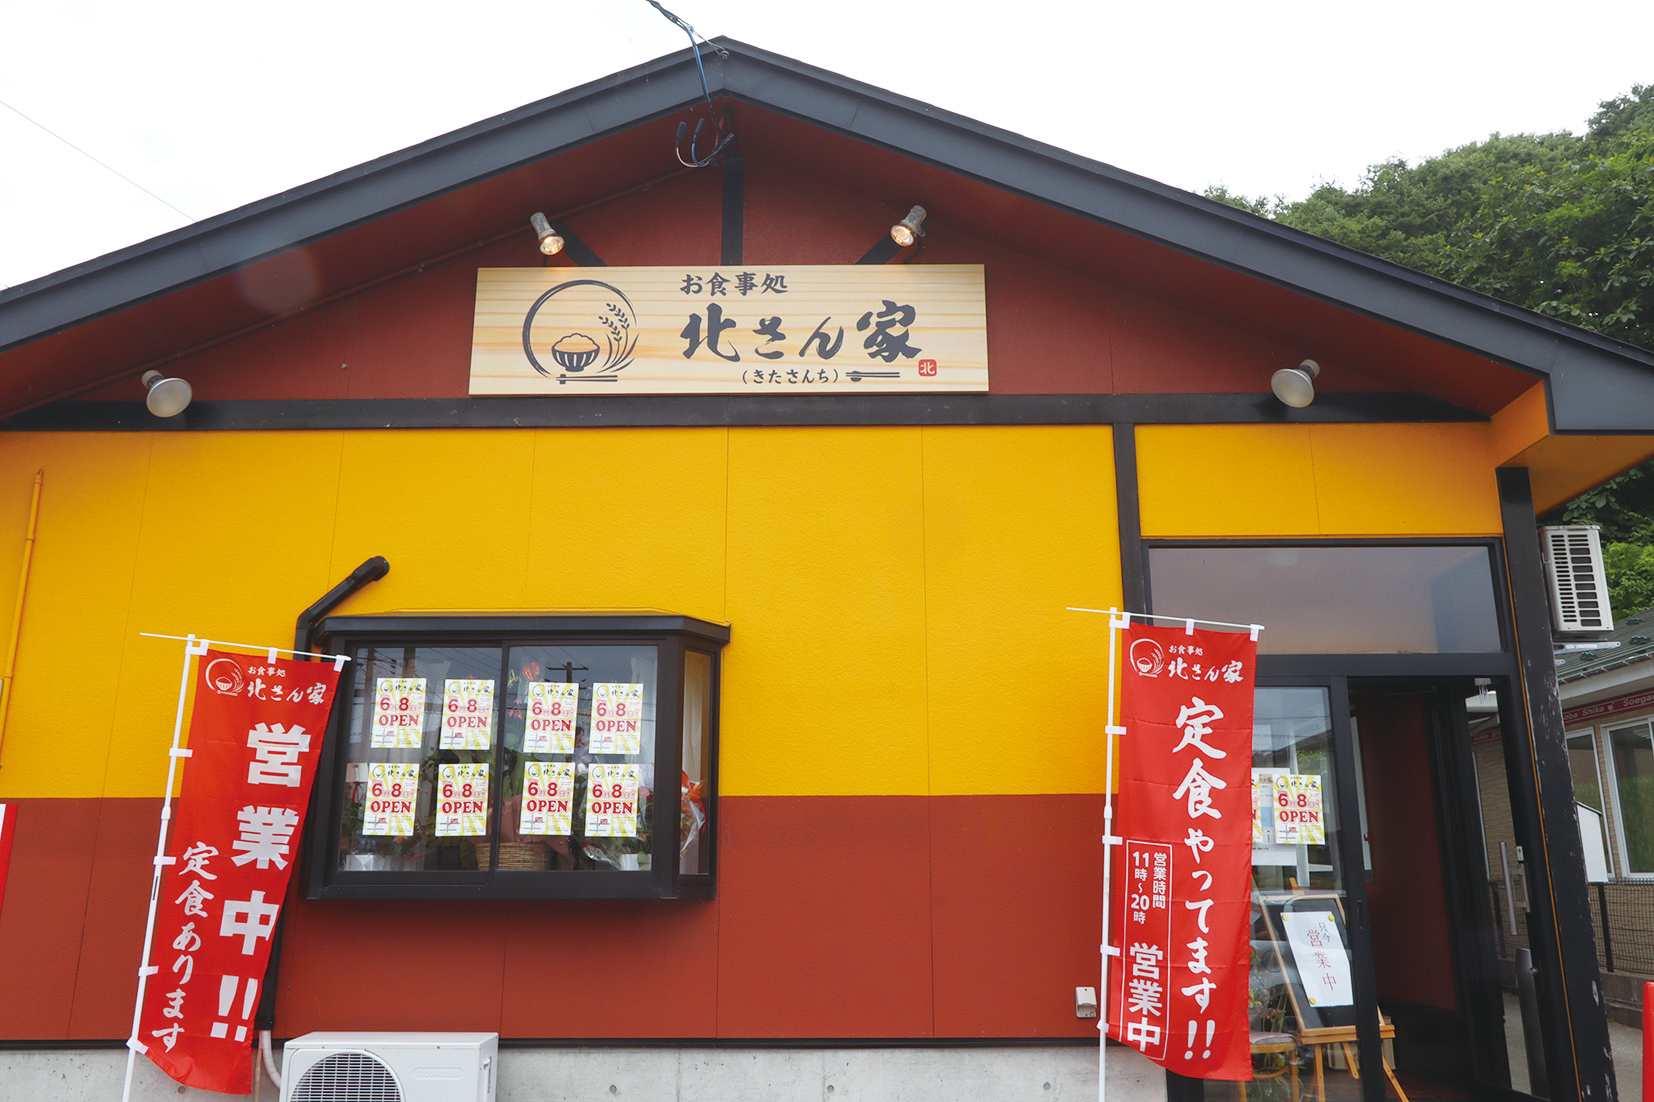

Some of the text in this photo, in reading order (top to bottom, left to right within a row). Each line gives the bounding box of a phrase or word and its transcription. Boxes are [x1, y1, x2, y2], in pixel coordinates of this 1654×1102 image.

[680, 271, 789, 296] お食事処
[680, 300, 922, 363] 北さん家
[919, 360, 937, 376] 北
[1168, 644, 1204, 656] お食事処
[247, 665, 287, 678] お食事処
[1168, 656, 1244, 684] 北さん家
[247, 678, 327, 705] 北さん家
[379, 714, 419, 726] OPEN
[1562, 705, 1605, 721] oba Shika
[447, 716, 487, 728] OPEN
[531, 719, 571, 731] OPEN
[596, 720, 637, 732] OPEN
[370, 801, 412, 813] OPEN
[442, 801, 483, 814] OPEN
[527, 800, 568, 812] OPEN
[592, 802, 633, 814] OPEN
[1279, 810, 1318, 823] OPEN
[210, 721, 311, 1042] 営業中!!
[1152, 851, 1168, 910] 営業時間
[1172, 696, 1227, 1060] 定食やってます!!
[151, 841, 220, 1054] 定食あります
[1306, 929, 1337, 991] 営業中
[1127, 942, 1163, 1052] 営業中
